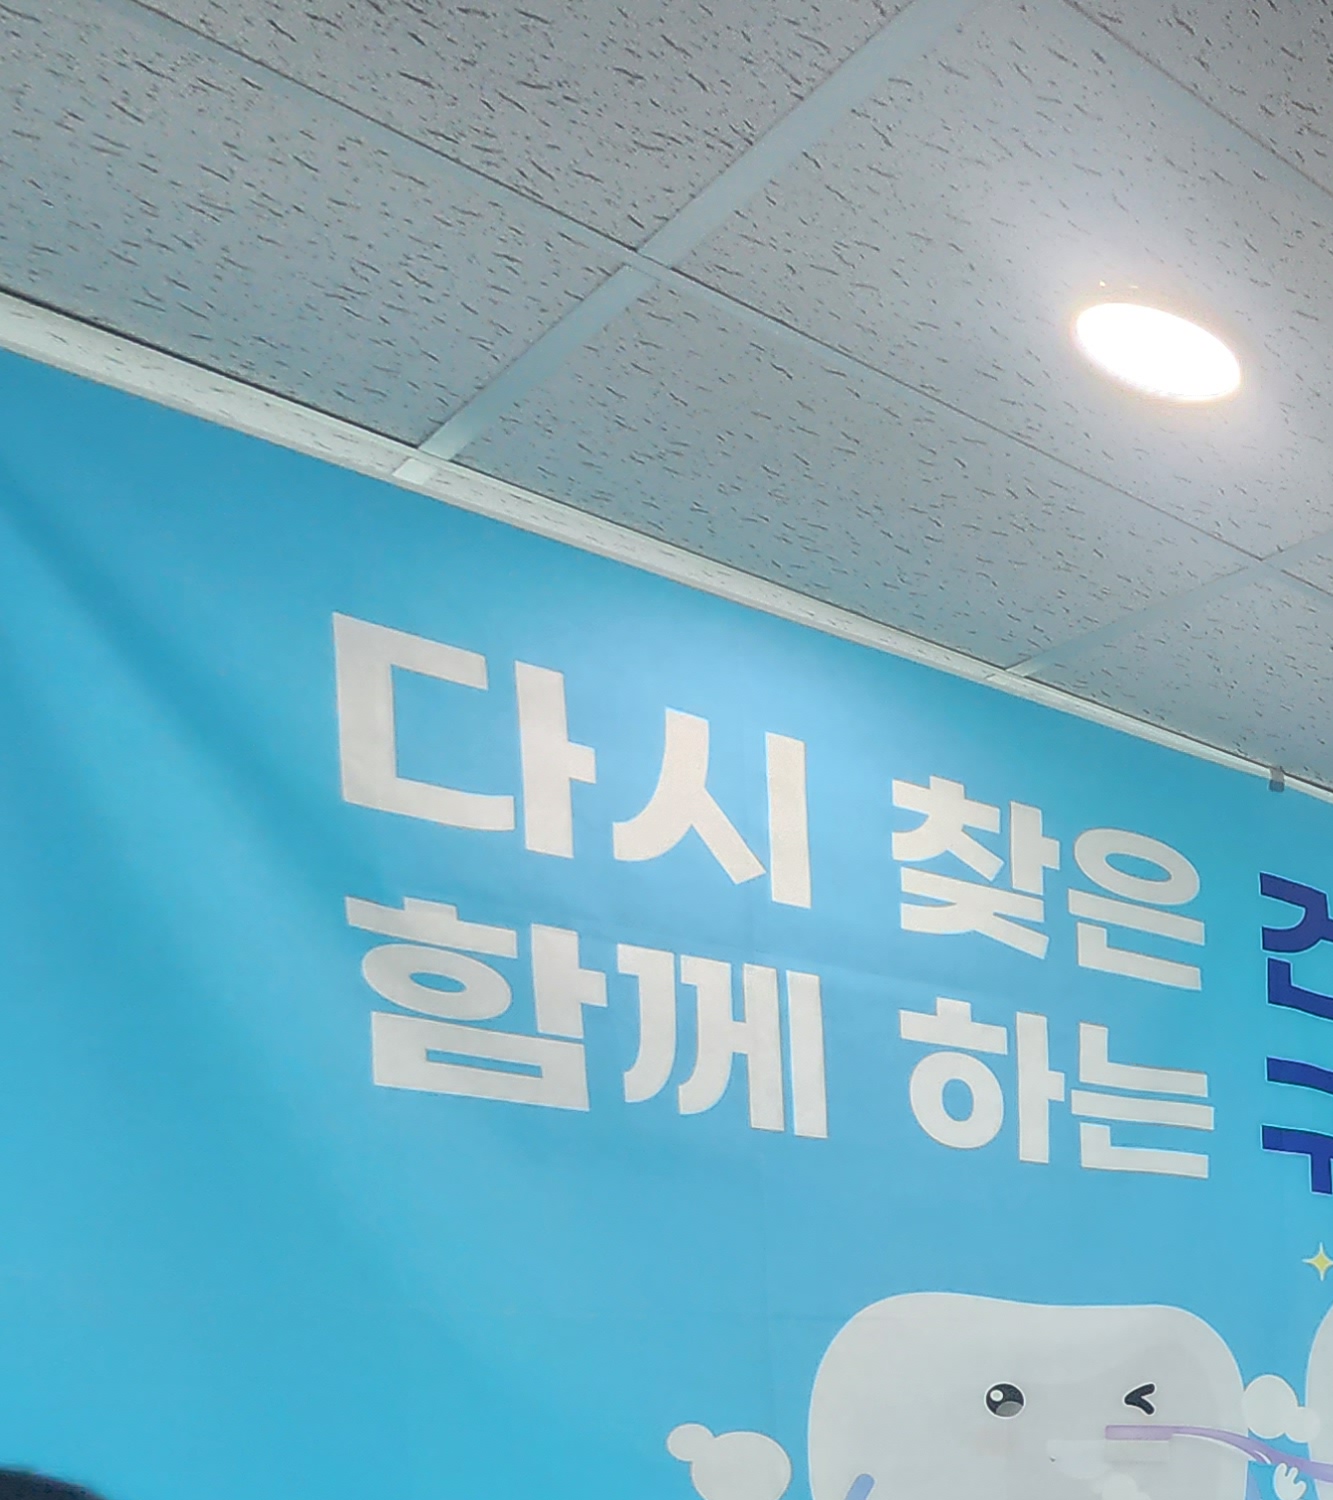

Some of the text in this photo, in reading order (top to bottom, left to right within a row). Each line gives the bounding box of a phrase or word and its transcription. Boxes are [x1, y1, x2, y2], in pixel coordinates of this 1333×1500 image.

[331, 611, 815, 910] 다시
[890, 775, 1205, 992] 찾은
[343, 895, 828, 1141] 함께
[899, 996, 1217, 1180] 하는
